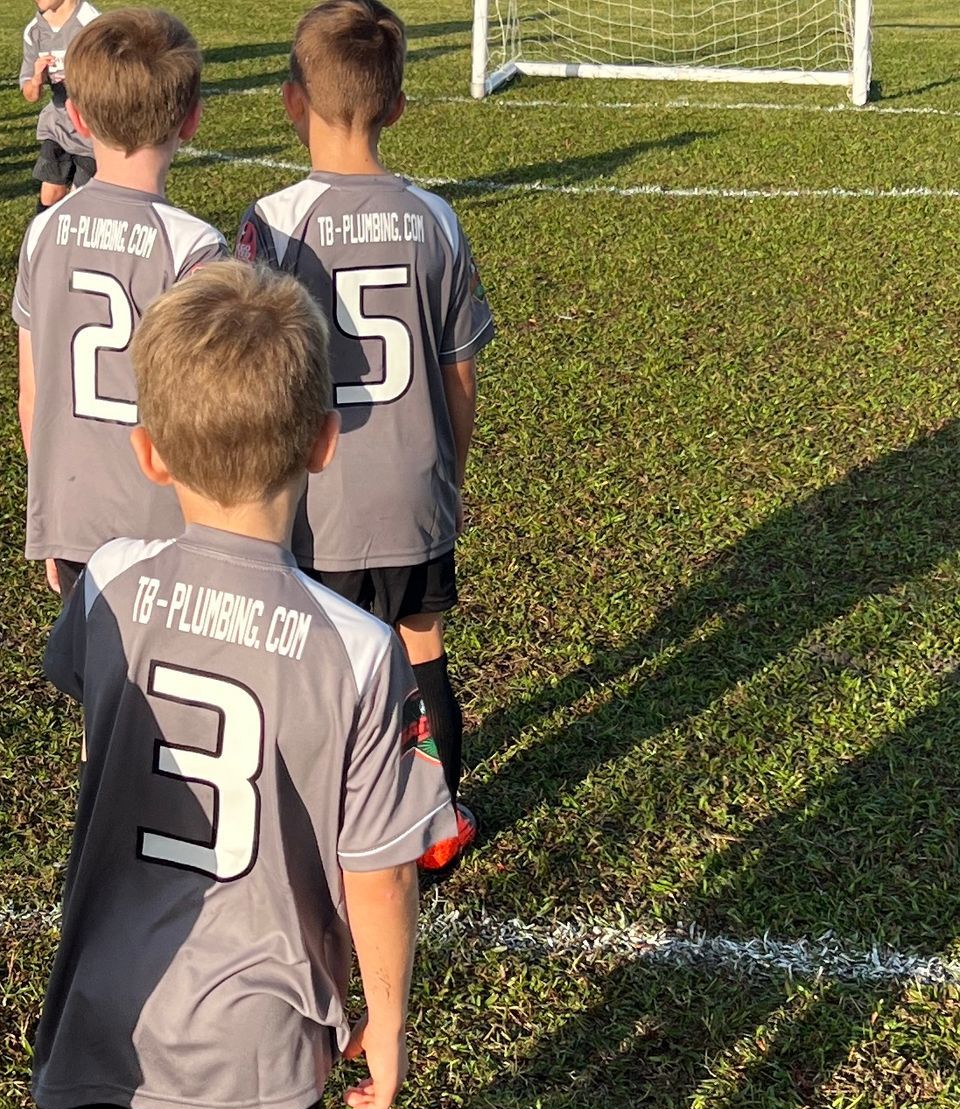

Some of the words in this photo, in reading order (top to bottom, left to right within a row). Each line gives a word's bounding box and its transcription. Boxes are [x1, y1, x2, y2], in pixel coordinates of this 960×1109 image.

[69, 268, 139, 425] 2
[333, 264, 414, 406] 5
[138, 660, 264, 882] 3
